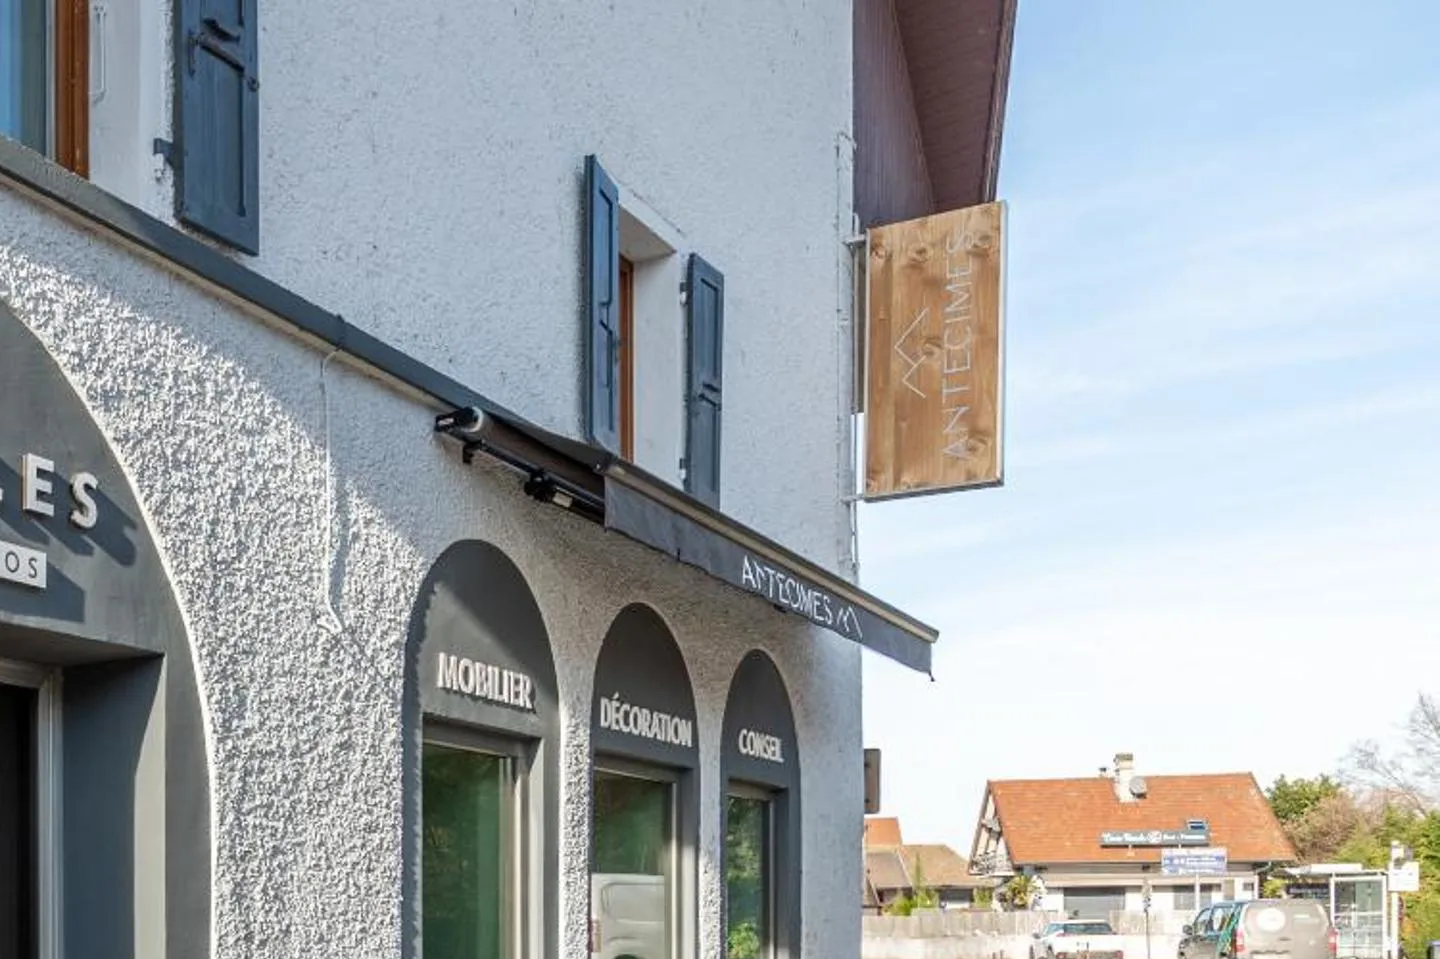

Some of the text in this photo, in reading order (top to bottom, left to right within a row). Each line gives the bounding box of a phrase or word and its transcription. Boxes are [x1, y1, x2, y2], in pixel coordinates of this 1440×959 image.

[436, 652, 533, 710] MOBILIER
[600, 692, 693, 748] DÉCORATION
[738, 728, 784, 764] CONSEIL
